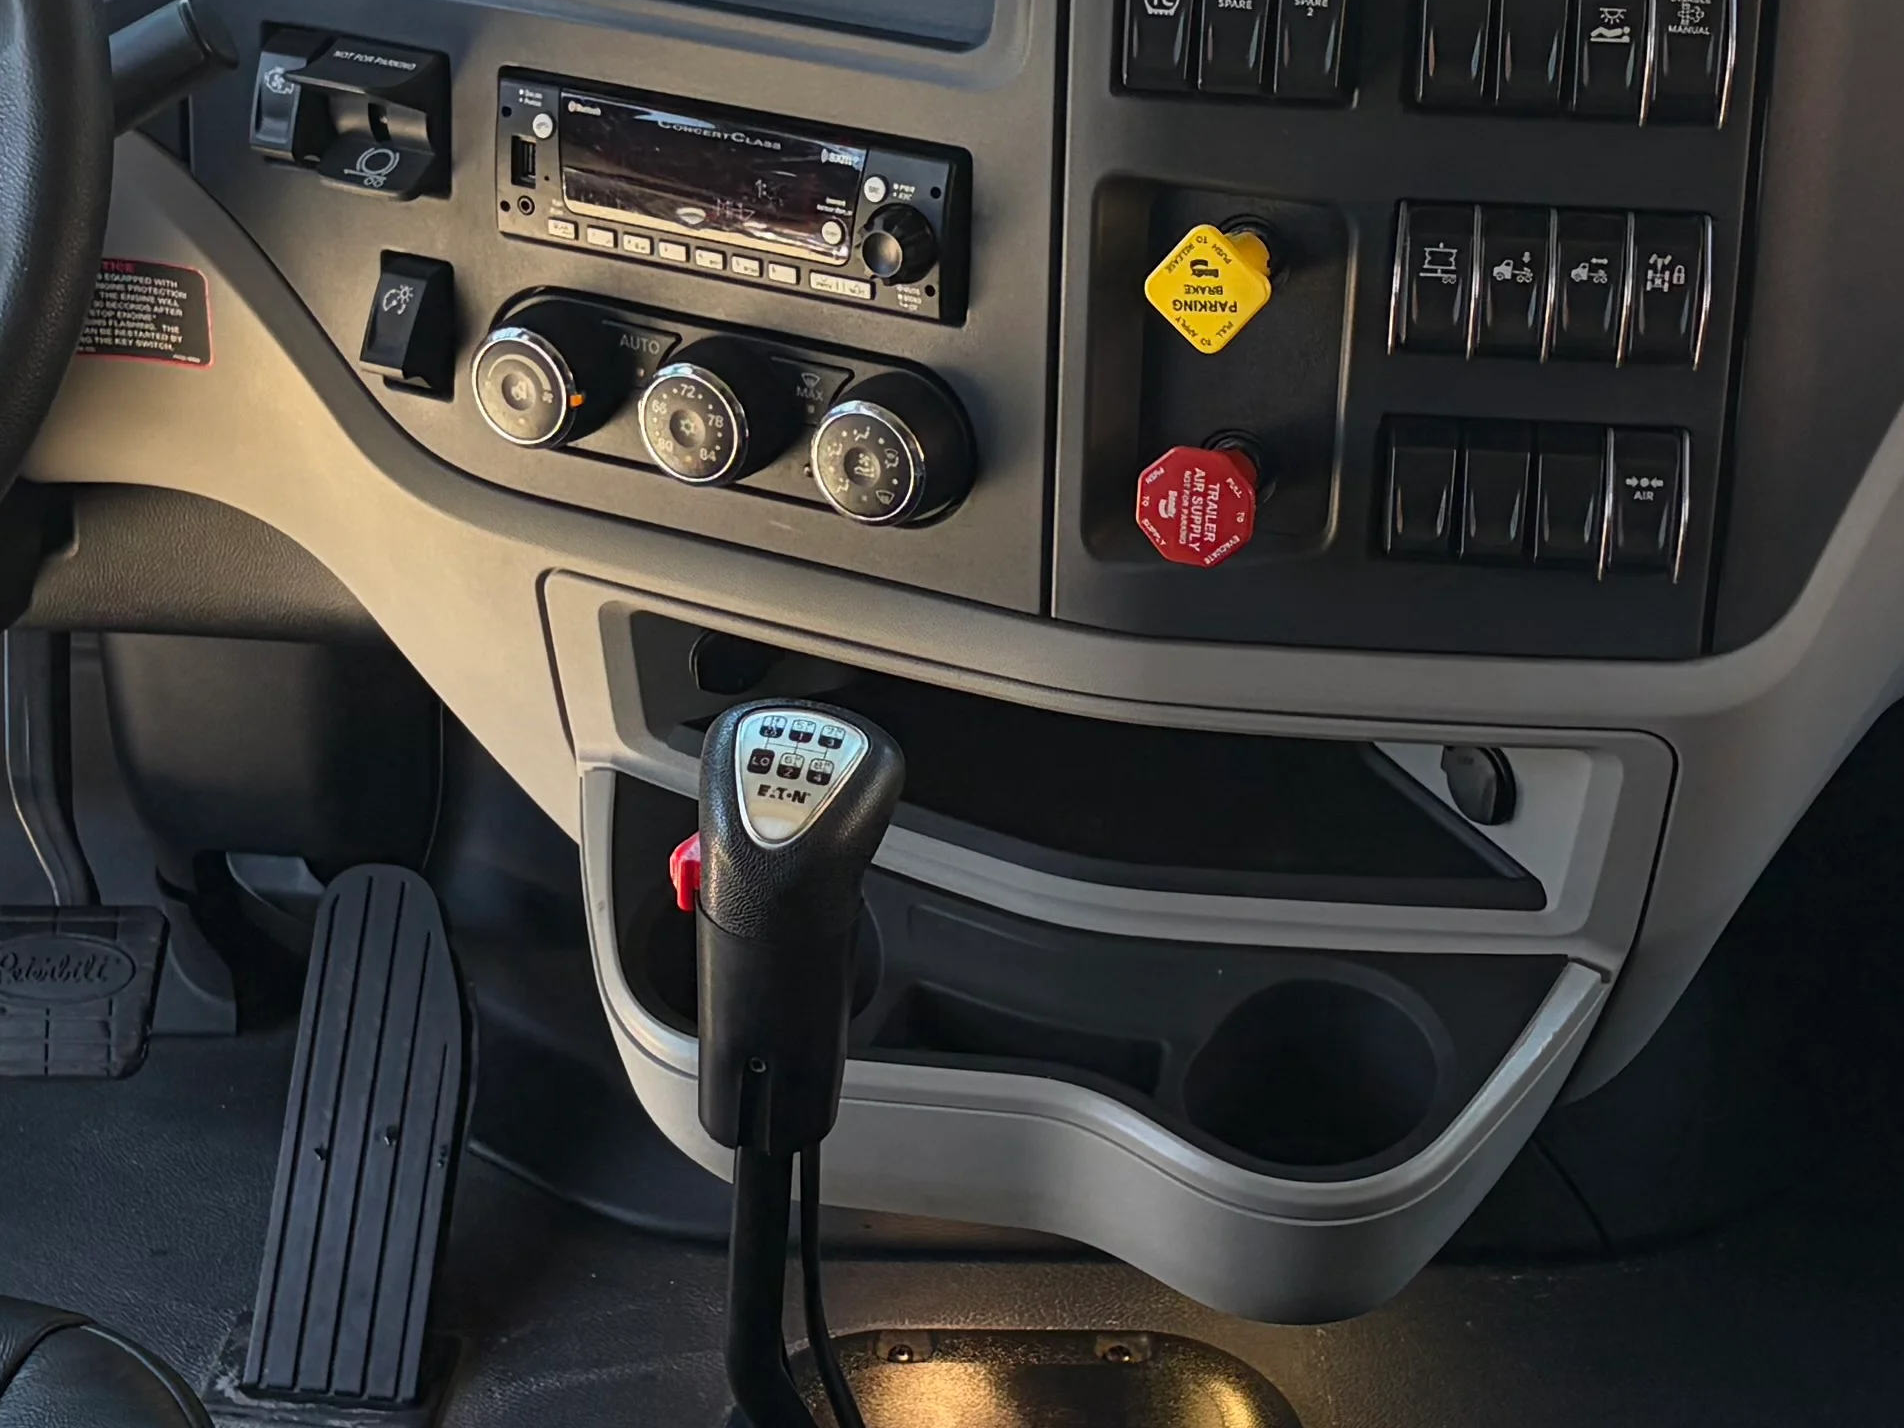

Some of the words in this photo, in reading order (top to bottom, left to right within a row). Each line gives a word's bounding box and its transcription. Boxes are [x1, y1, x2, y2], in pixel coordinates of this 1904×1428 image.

[1307, 7, 1314, 17] 2
[1668, 24, 1710, 35] MANUAL
[333, 50, 355, 60] NOT
[353, 53, 375, 62] FOR
[1196, 235, 1208, 244] TO
[1165, 243, 1195, 274] RELEASE
[1211, 243, 1232, 264] PUSH
[154, 278, 178, 288] WITH
[1184, 284, 1223, 295] BRAKE
[99, 291, 118, 299] THE
[128, 285, 187, 300] PROTECTION
[153, 306, 183, 317] AFTER
[1172, 299, 1237, 313] PARKING
[162, 324, 180, 334] THE
[1175, 316, 1198, 337] APPLY
[1216, 321, 1234, 338] PULL
[114, 338, 133, 347] KEY
[171, 335, 183, 343] BY
[620, 334, 660, 355] AUTO
[1200, 338, 1211, 346] TO
[680, 384, 695, 399] 72
[797, 385, 824, 402] MAX
[708, 414, 724, 429] 78
[699, 448, 717, 462] 84
[1184, 471, 1192, 488] NOT
[1193, 467, 1206, 492] AIR
[1142, 495, 1150, 507] TO
[1181, 489, 1190, 507] FOR
[1633, 491, 1654, 501] AIR
[1204, 482, 1220, 542] TRAILER
[1236, 512, 1245, 523] TO
[1189, 495, 1203, 552] SUPPLY
[752, 756, 770, 767] LO
